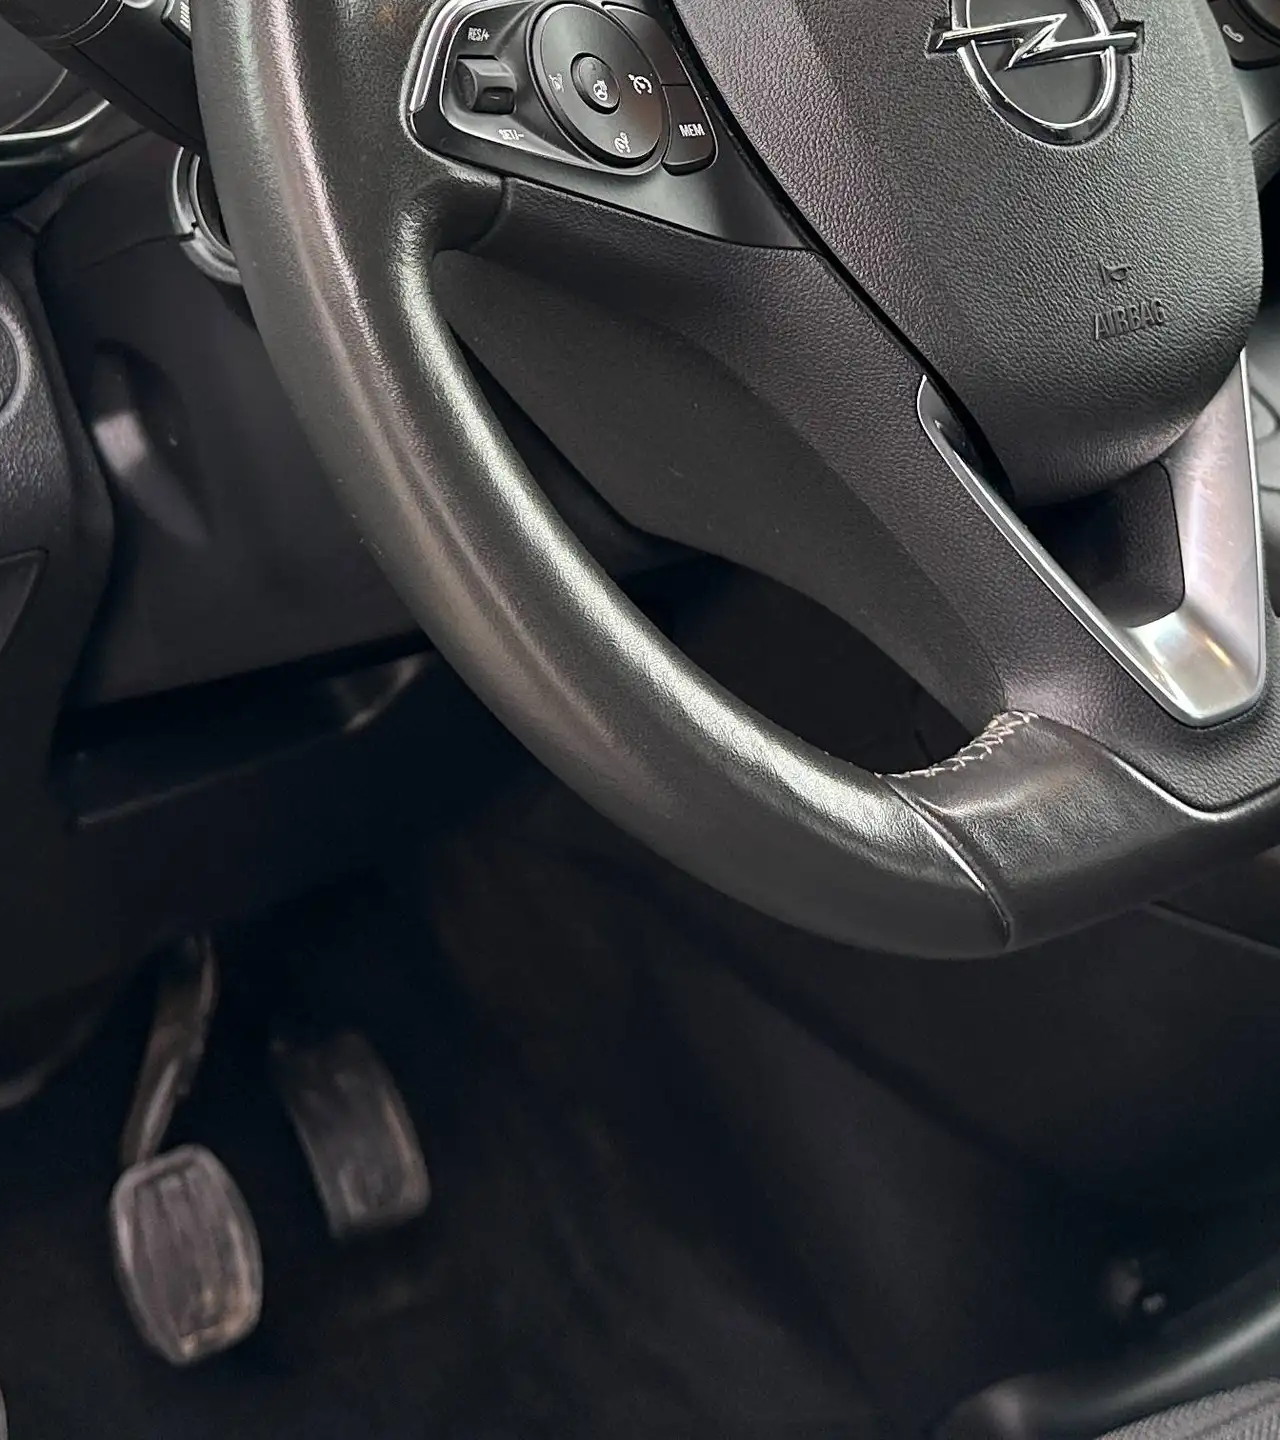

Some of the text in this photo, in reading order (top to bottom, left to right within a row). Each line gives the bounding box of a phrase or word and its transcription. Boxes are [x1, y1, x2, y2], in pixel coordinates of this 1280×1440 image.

[467, 27, 490, 42] RES/+
[678, 123, 706, 137] MEM
[1094, 296, 1167, 341] AIRBAG
